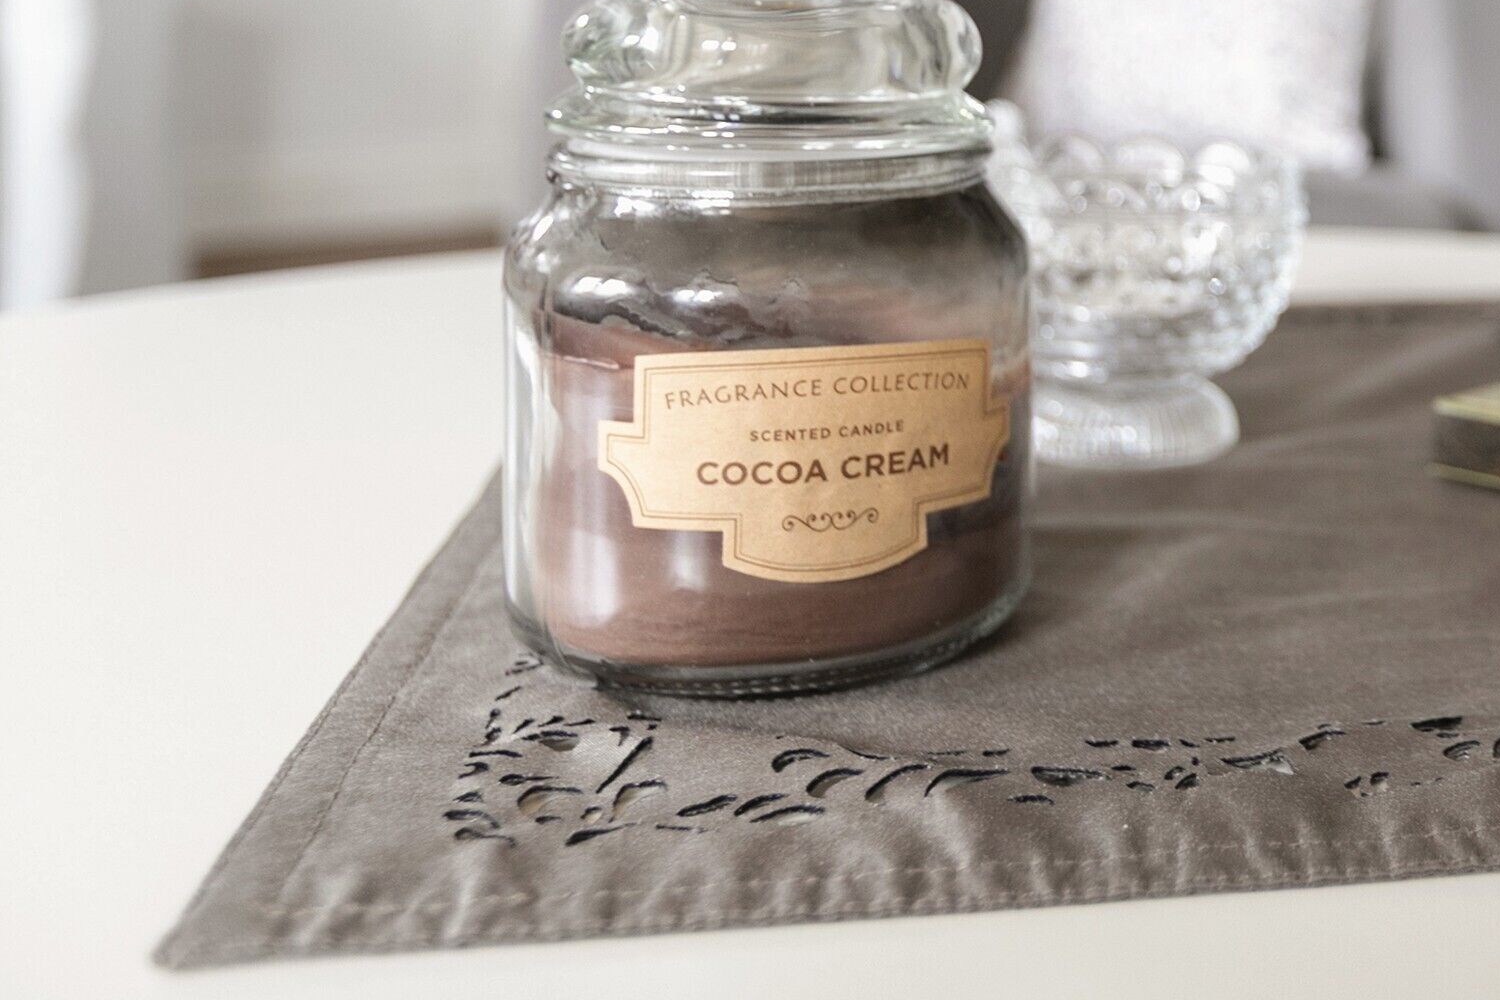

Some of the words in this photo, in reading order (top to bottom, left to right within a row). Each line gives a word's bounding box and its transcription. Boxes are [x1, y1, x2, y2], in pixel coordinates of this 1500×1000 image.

[665, 378, 822, 409] FRAGRANCE
[833, 371, 969, 395] COLLECTION
[750, 428, 832, 442] SCENTED
[839, 419, 905, 438] CANDLE
[697, 459, 828, 486] COCOA
[841, 443, 950, 480] CREAM
